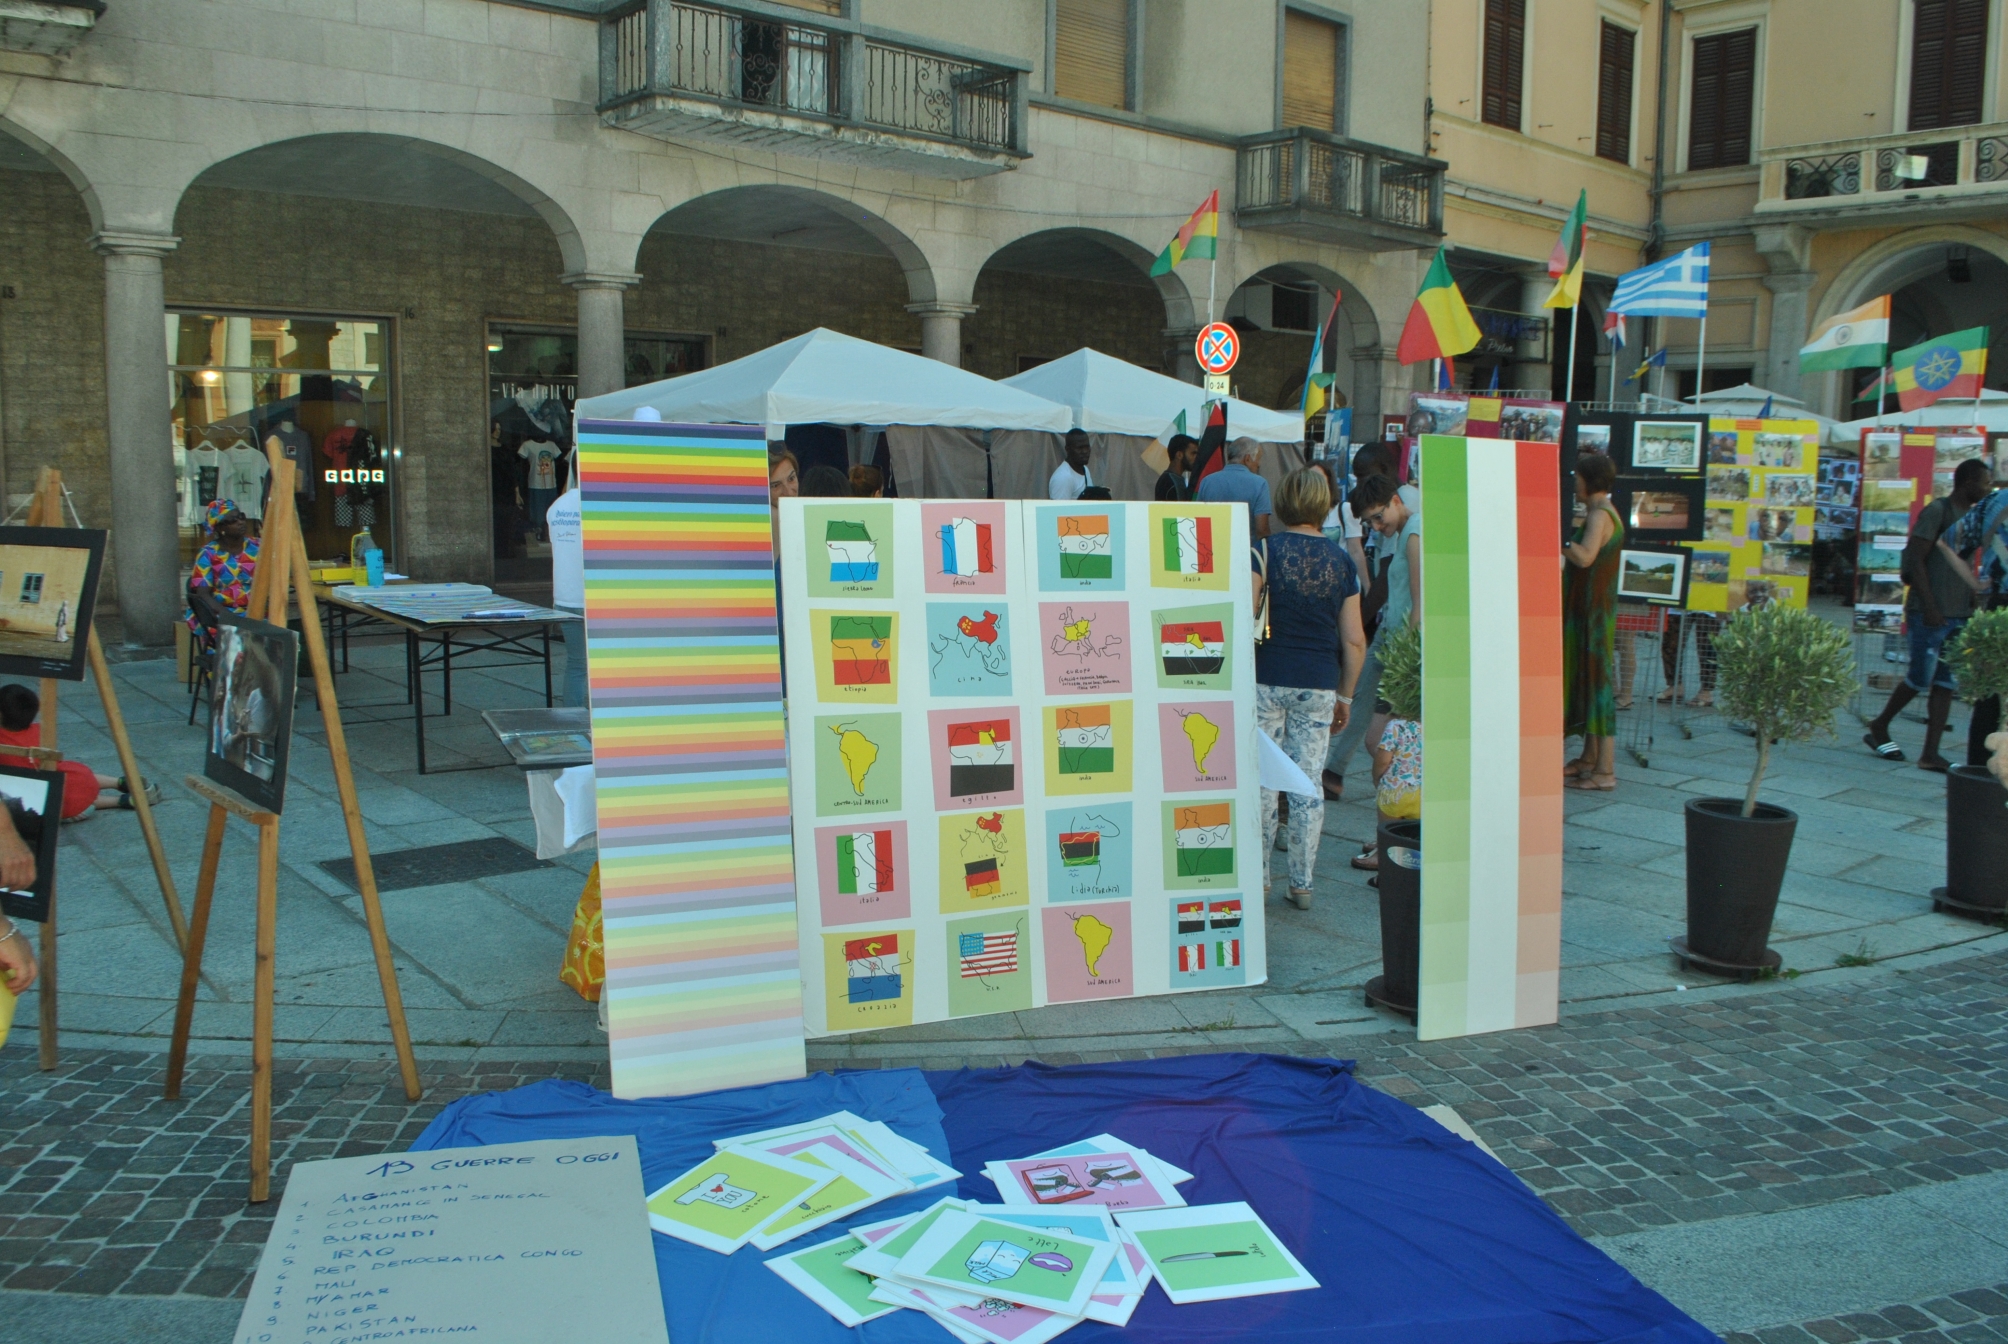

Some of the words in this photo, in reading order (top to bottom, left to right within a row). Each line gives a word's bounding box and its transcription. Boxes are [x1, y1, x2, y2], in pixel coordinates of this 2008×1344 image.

[532, 383, 576, 401] dell'O
[859, 896, 880, 905] italia
[431, 1156, 535, 1171] GUERRE
[556, 1151, 620, 1165] OGGI
[444, 1196, 459, 1204] IN
[715, 1190, 743, 1205] YOU
[326, 1214, 439, 1229] COLOMBIA
[322, 1229, 435, 1245] BURUNDI
[332, 1246, 396, 1260] IRAQ
[371, 1254, 505, 1271] DEMOCRATICA
[520, 1248, 583, 1259] CONGO
[315, 1279, 356, 1290] MALI
[305, 1288, 390, 1305] MYAMAR
[306, 1303, 379, 1321] NIGER
[305, 1315, 417, 1336] PAKISTAN
